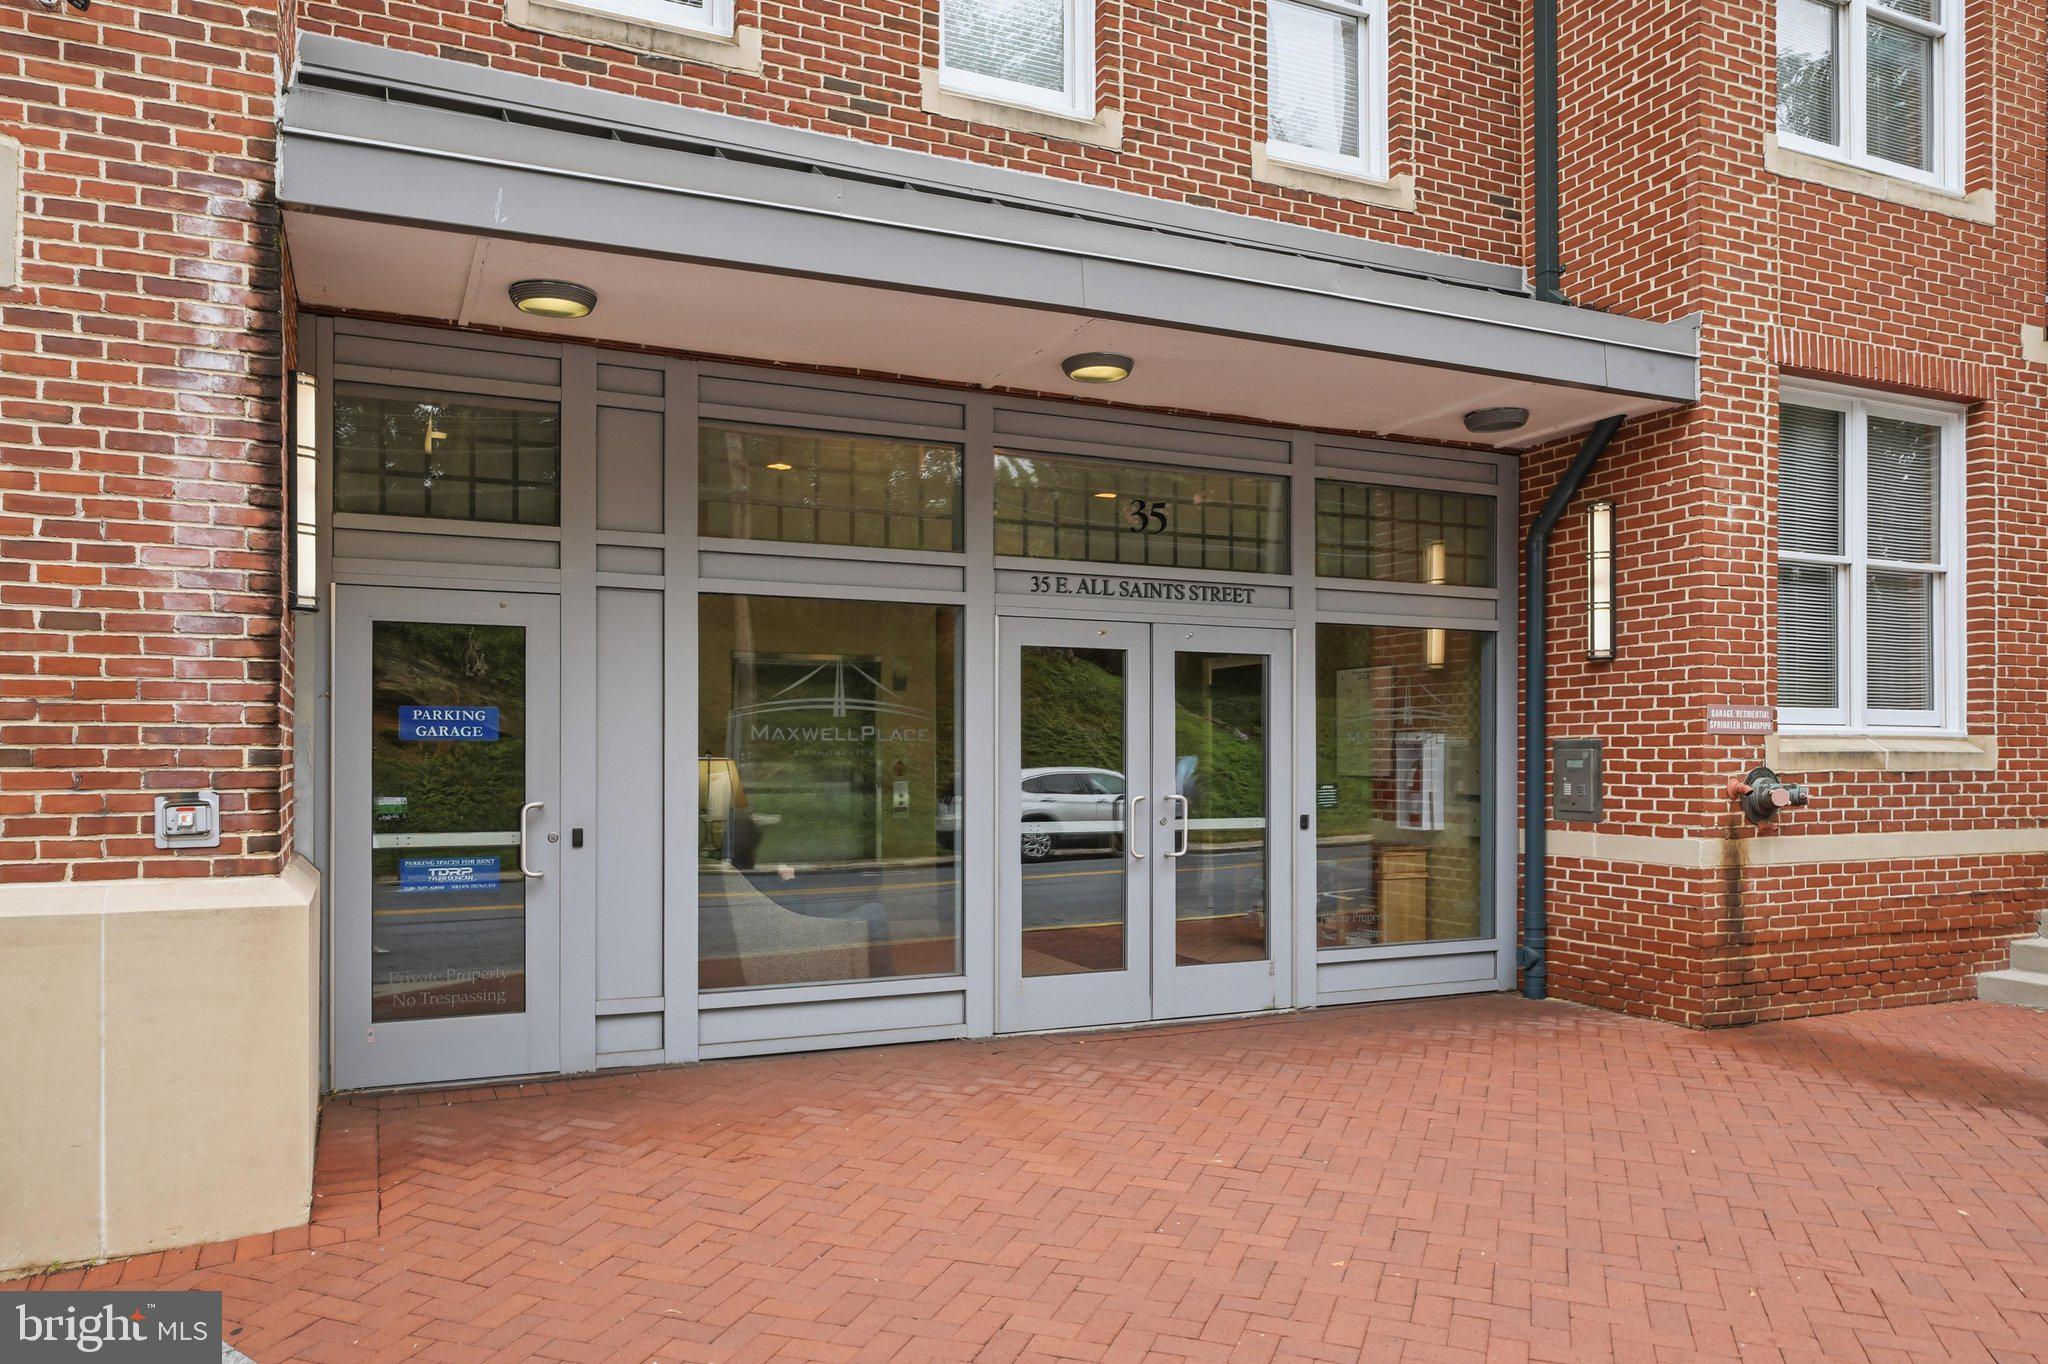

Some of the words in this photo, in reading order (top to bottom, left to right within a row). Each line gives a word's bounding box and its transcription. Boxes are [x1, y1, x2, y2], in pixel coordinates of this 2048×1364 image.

[1130, 499, 1167, 534] 35
[1030, 576, 1050, 593] 35
[1055, 577, 1072, 594] E.
[1077, 578, 1115, 596] ALL
[1119, 581, 1185, 600] SAINTS
[1189, 585, 1255, 604] STREET
[412, 709, 486, 721] PARKING
[1711, 709, 1734, 718] GARAGE
[1736, 710, 1770, 719] RESIDENTIAL
[415, 726, 483, 737] GARAGE
[1709, 720, 1740, 729] SPRINKLER
[1743, 721, 1772, 730] STANDPIPE
[389, 970, 441, 984] Private
[446, 967, 508, 984] Property
[393, 994, 416, 1007] No
[420, 988, 506, 1008] Trespassing
